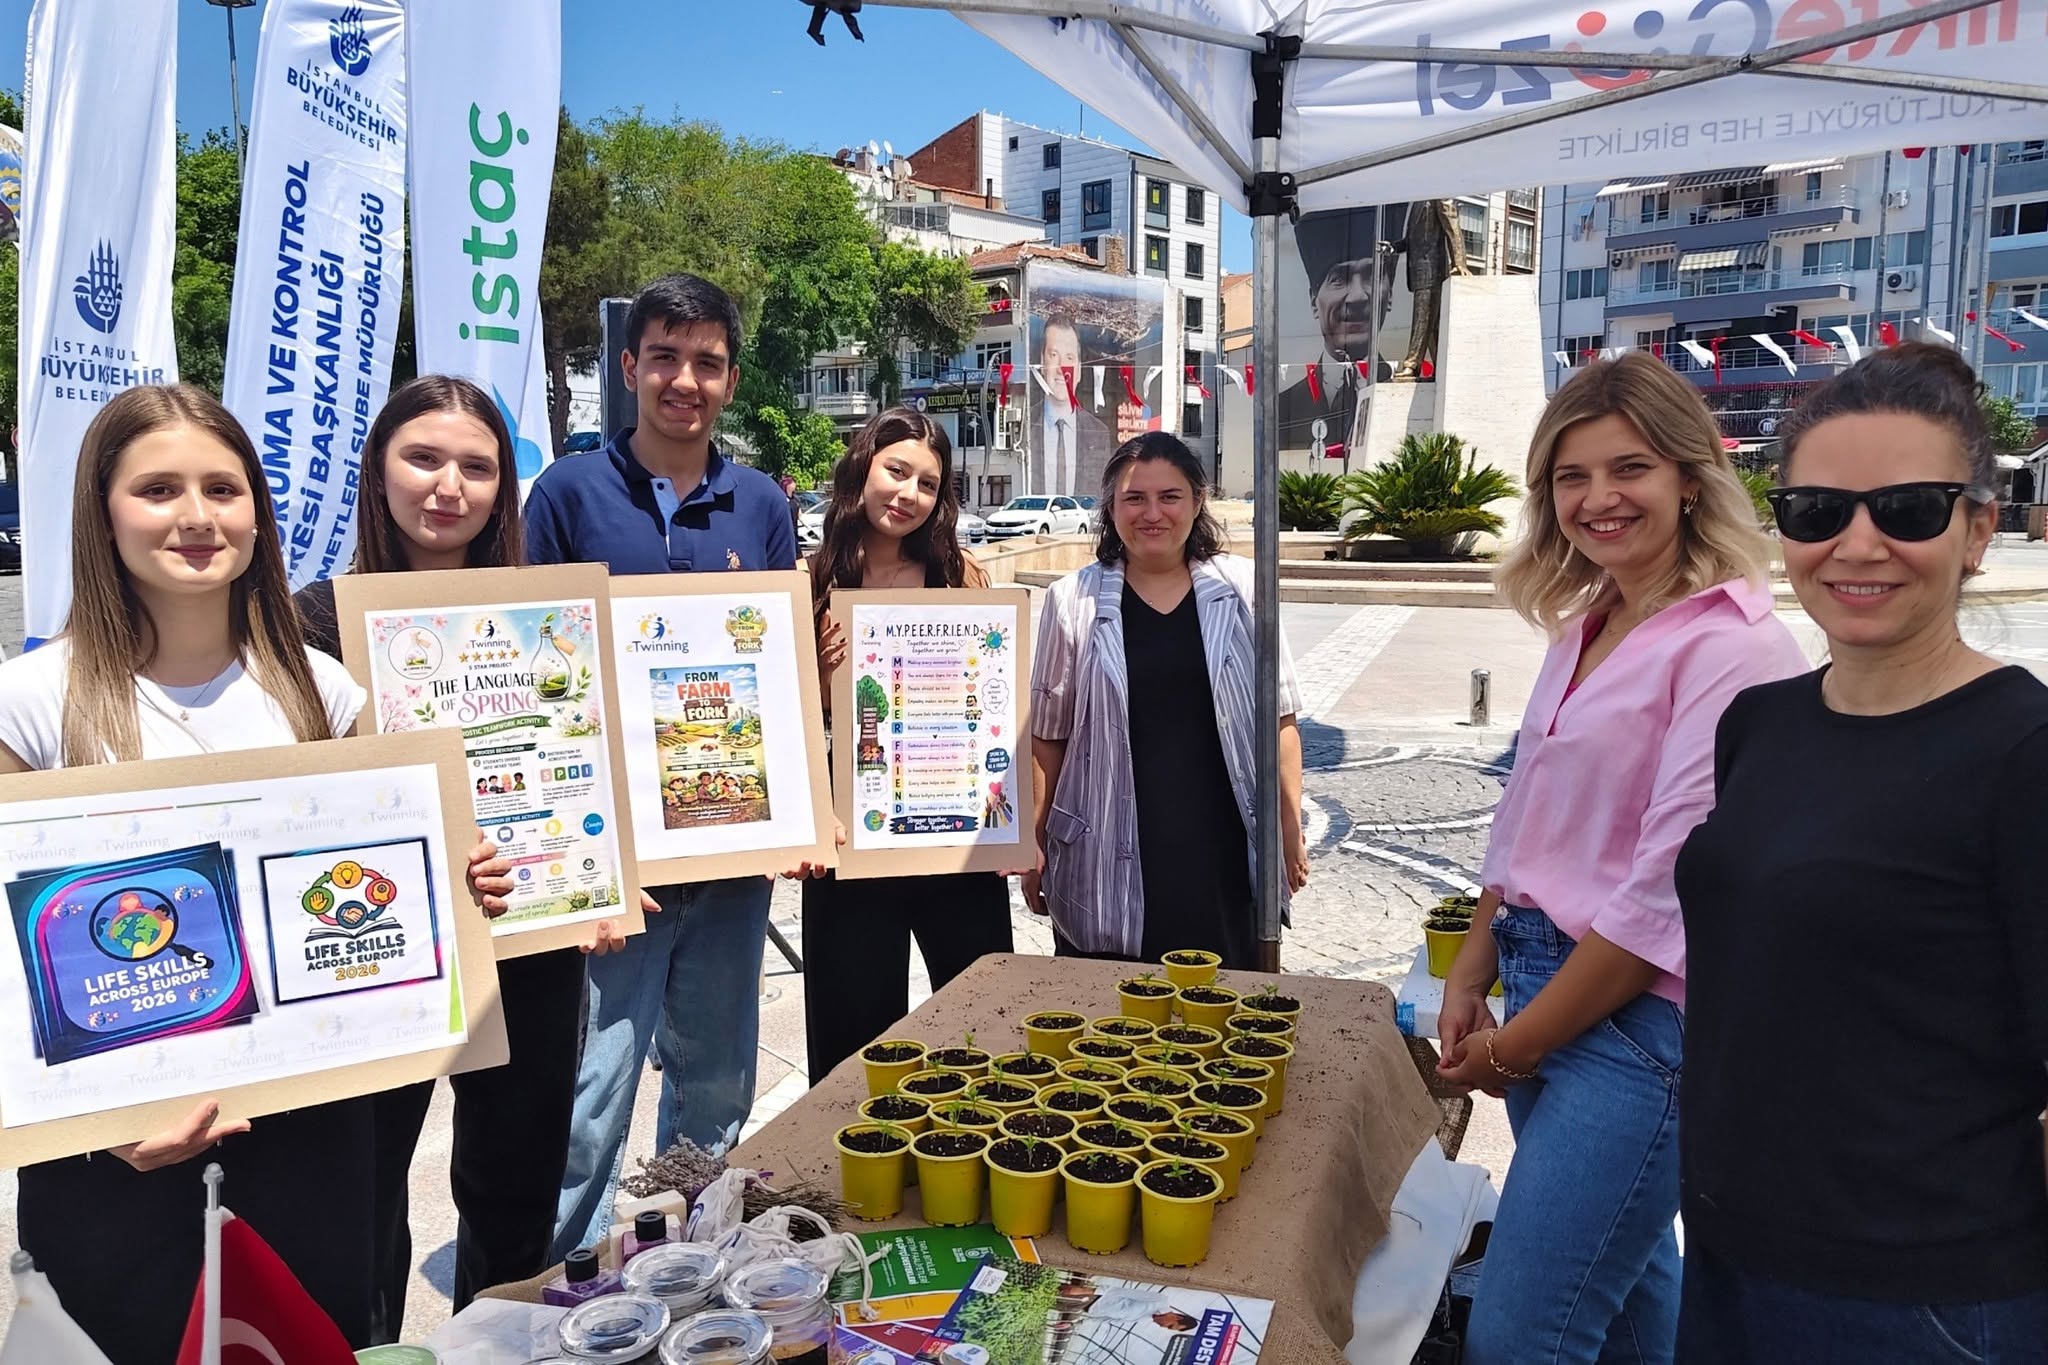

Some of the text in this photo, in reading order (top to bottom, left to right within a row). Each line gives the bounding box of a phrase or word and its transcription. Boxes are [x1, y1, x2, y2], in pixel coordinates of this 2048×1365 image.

[306, 58, 382, 115] İSTANBUL
[286, 66, 397, 145] BÜYÜKŞEHİR
[303, 100, 380, 152] BELEDİYESİ
[459, 101, 530, 345] istaç
[271, 160, 310, 340] KONTROL
[356, 192, 385, 376] MÜDÜRLÜĞÜ
[266, 343, 297, 395] VE
[288, 249, 345, 580] RESİ BAŞKANLIĞI
[626, 639, 690, 654] eTwinning
[489, 661, 512, 669] PROJECT
[893, 657, 902, 667] M
[684, 671, 719, 683] FROM
[894, 670, 901, 680] Y
[429, 672, 538, 699] THE LANGUAGE
[676, 682, 731, 700] FARM
[894, 683, 901, 693] P
[441, 690, 539, 724] OF SPRING
[699, 699, 711, 707] TO
[895, 696, 900, 706] E
[686, 706, 726, 721] FORK
[895, 709, 900, 719] E
[894, 723, 901, 733] R
[894, 754, 901, 763] R
[895, 779, 900, 788] E
[895, 791, 902, 800] N
[895, 804, 902, 813] D
[304, 933, 406, 961] LIFE SKILLS
[307, 948, 406, 972] ACROSS EUROPE
[84, 951, 208, 994] LIFE SKILLS
[335, 962, 381, 981] 2026
[89, 968, 210, 1007] ACROSS EUROPE
[130, 990, 177, 1013] 2026
[1203, 1313, 1227, 1337] TAM
